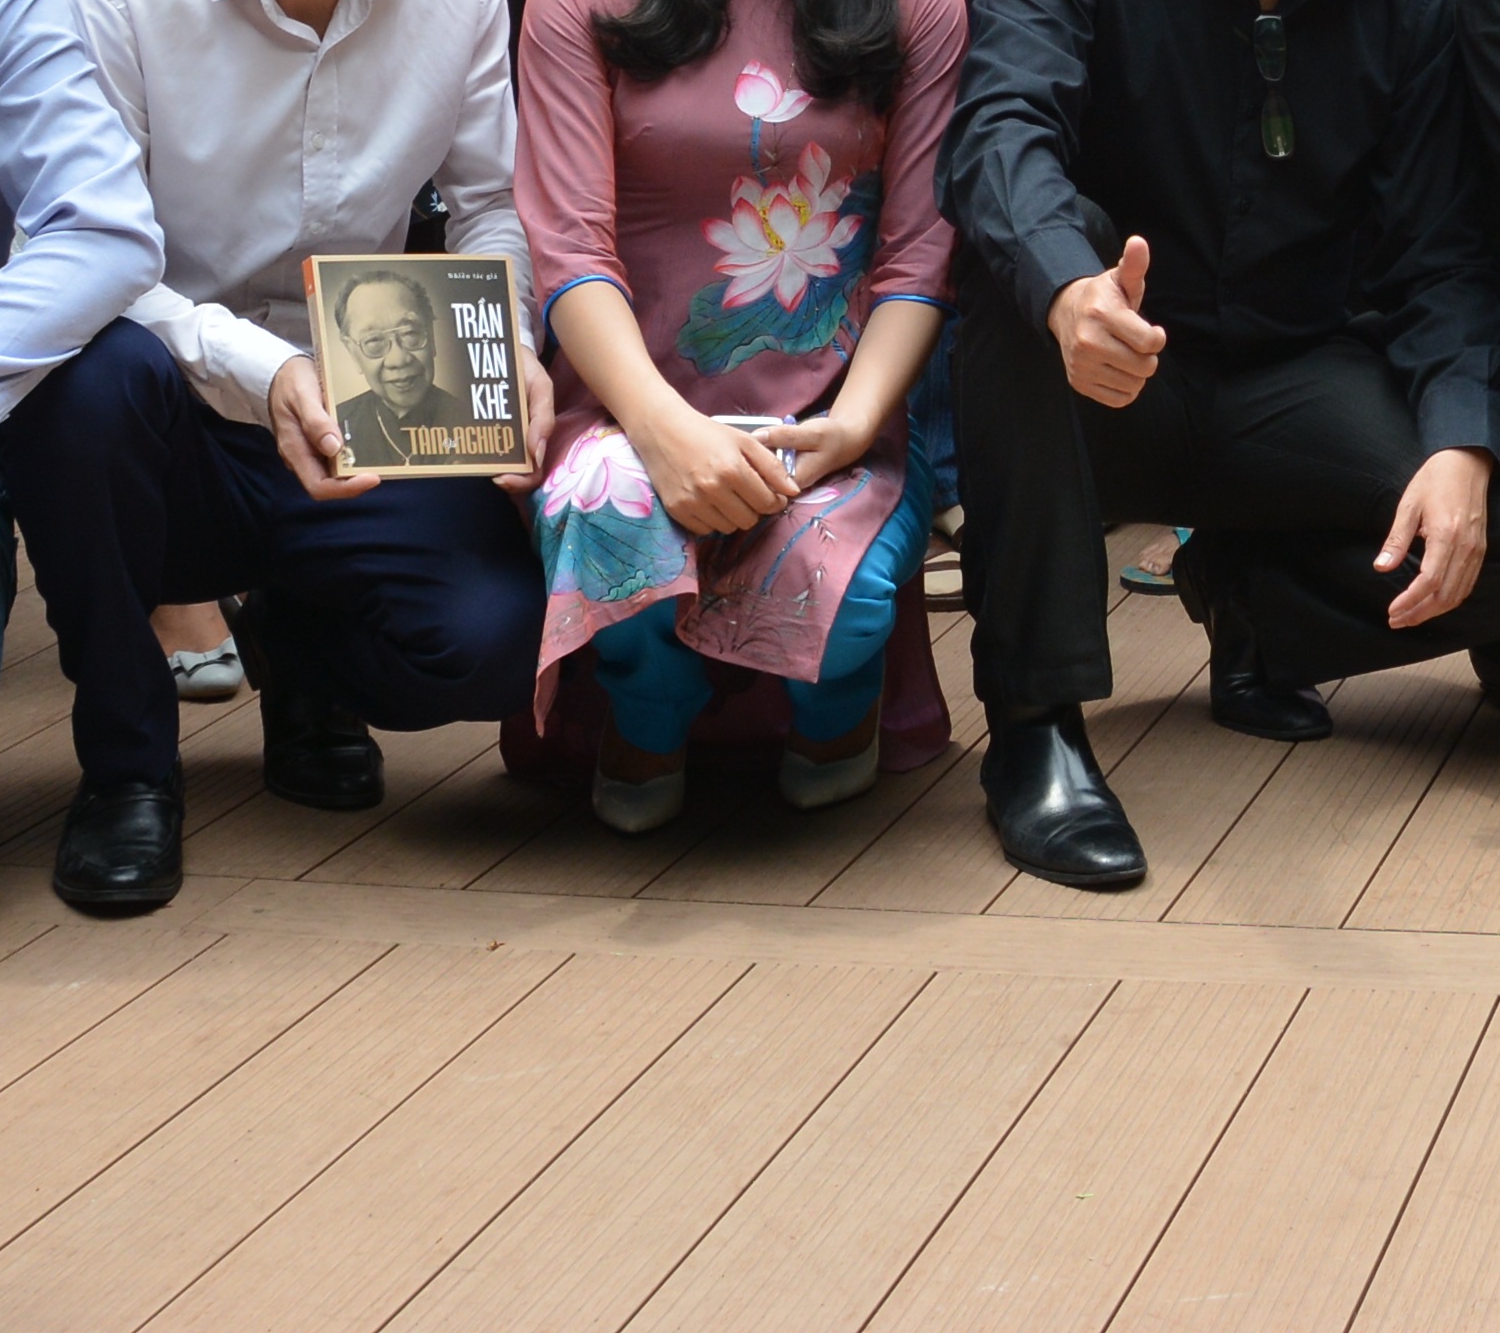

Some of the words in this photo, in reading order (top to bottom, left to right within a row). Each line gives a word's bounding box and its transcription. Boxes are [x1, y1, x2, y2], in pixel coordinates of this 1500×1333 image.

[451, 297, 505, 339] TRẦN
[467, 338, 509, 379] VĂN
[470, 380, 513, 420] KHÊ
